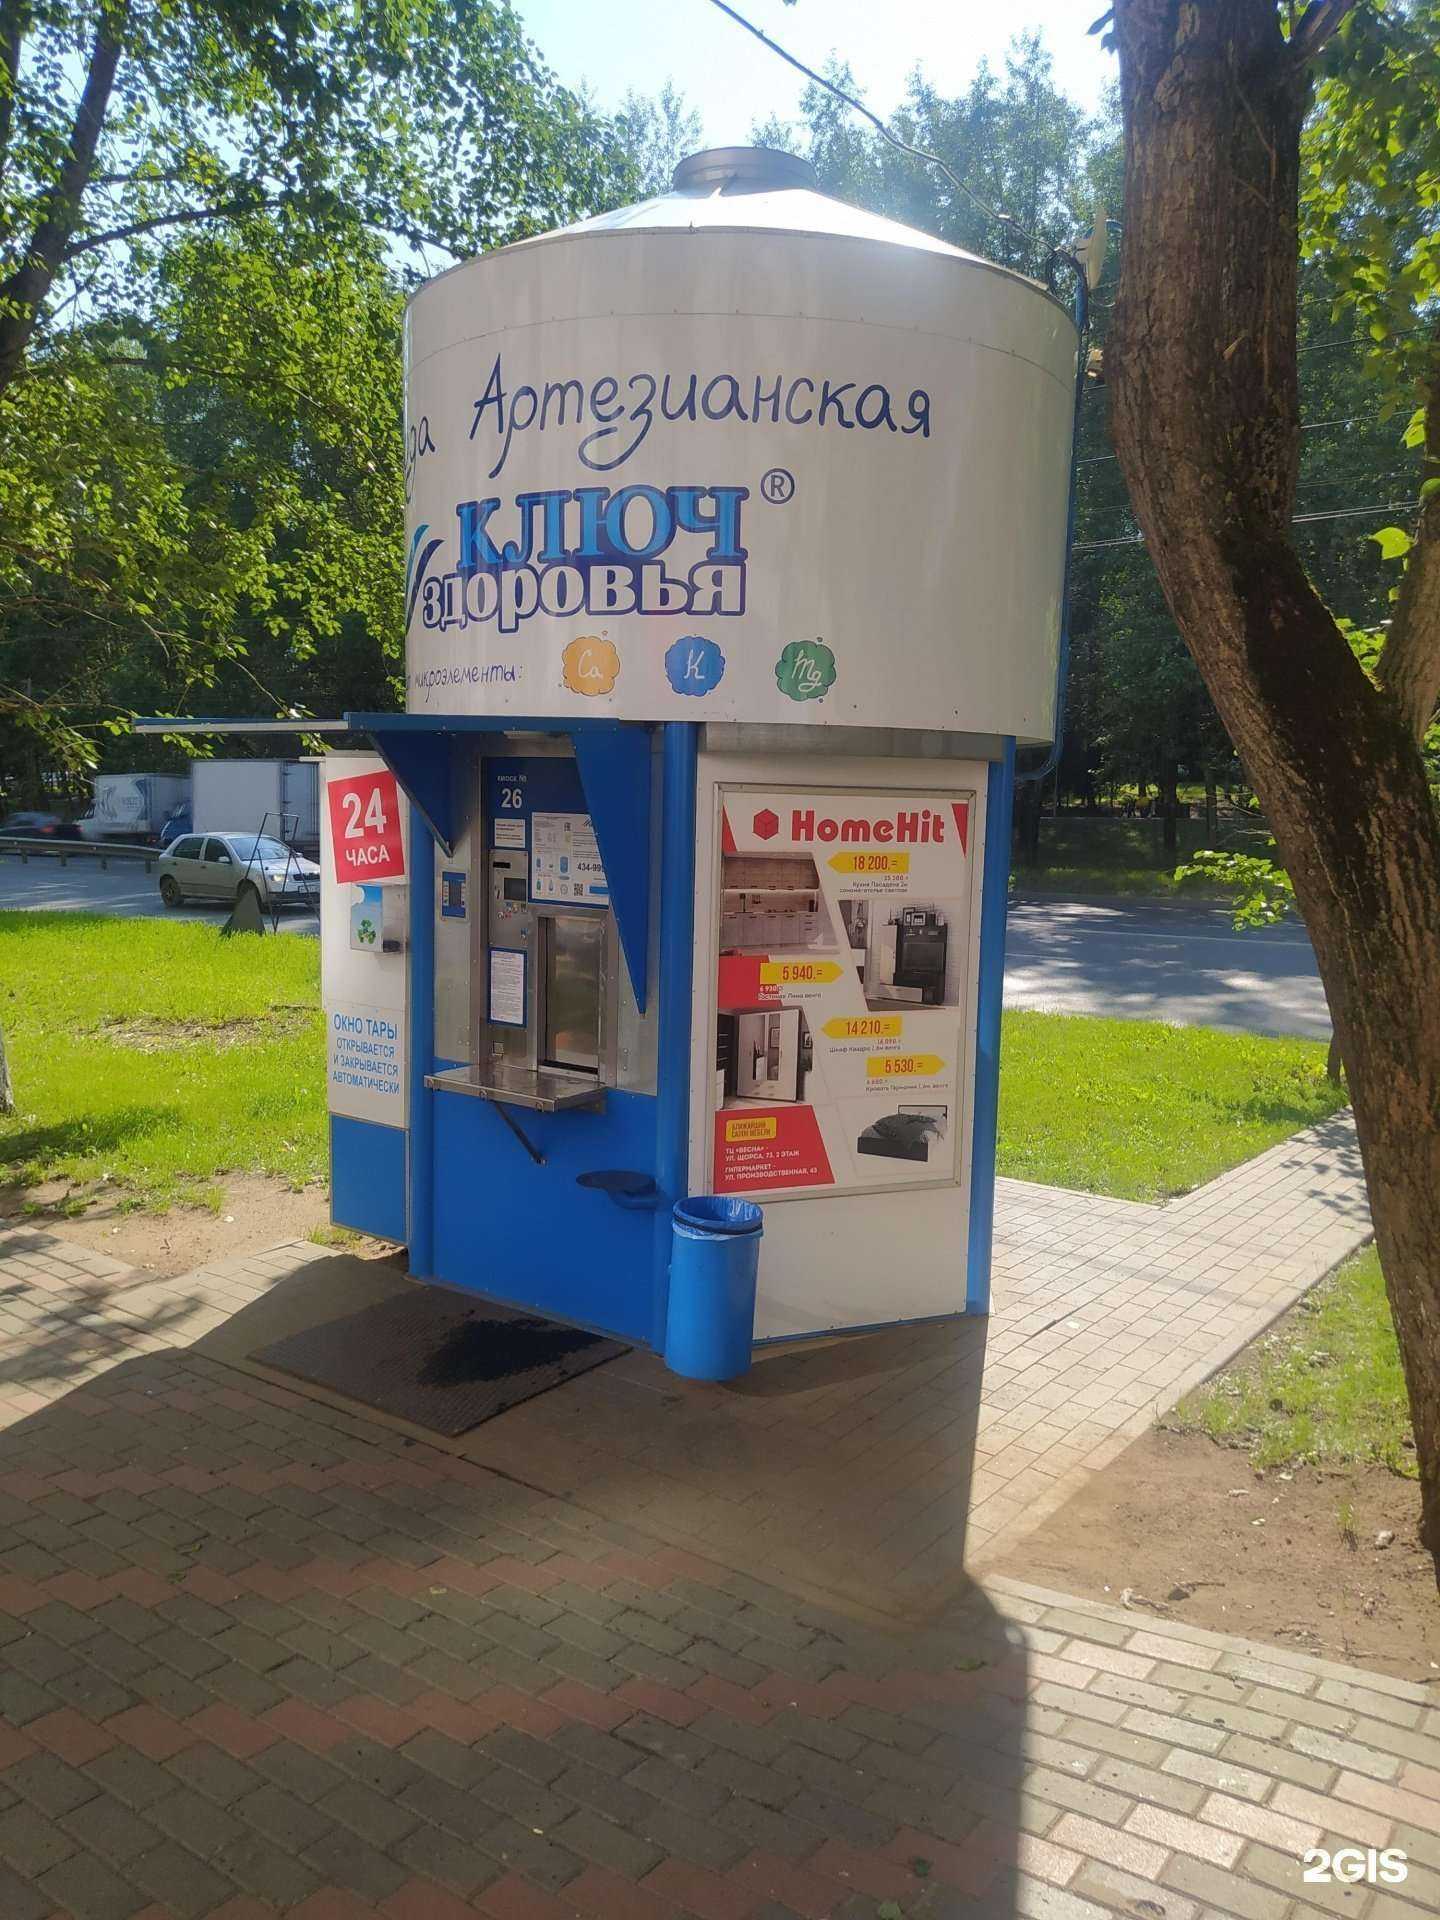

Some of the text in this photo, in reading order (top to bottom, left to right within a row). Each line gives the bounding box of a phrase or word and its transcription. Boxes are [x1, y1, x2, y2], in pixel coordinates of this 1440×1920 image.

[469, 352, 931, 479] Артезианская
[456, 484, 750, 571] КЛЮЧ
[577, 650, 603, 678] Ca
[684, 650, 705, 679] K
[792, 650, 822, 691] Mg
[501, 788, 522, 808] 26
[342, 788, 387, 839] 24
[791, 808, 944, 843] HomeHit
[345, 844, 390, 867] ЧАСА
[854, 856, 865, 870] 18
[333, 1014, 397, 1040] ОКНО ТАРЫ
[336, 1037, 395, 1058] ОТКРЫВАЕТСЯ
[333, 1054, 398, 1077] И ЗАКРЫВАЕТСЯ
[333, 1071, 399, 1095] АВТОМАТИЧЕСКИ
